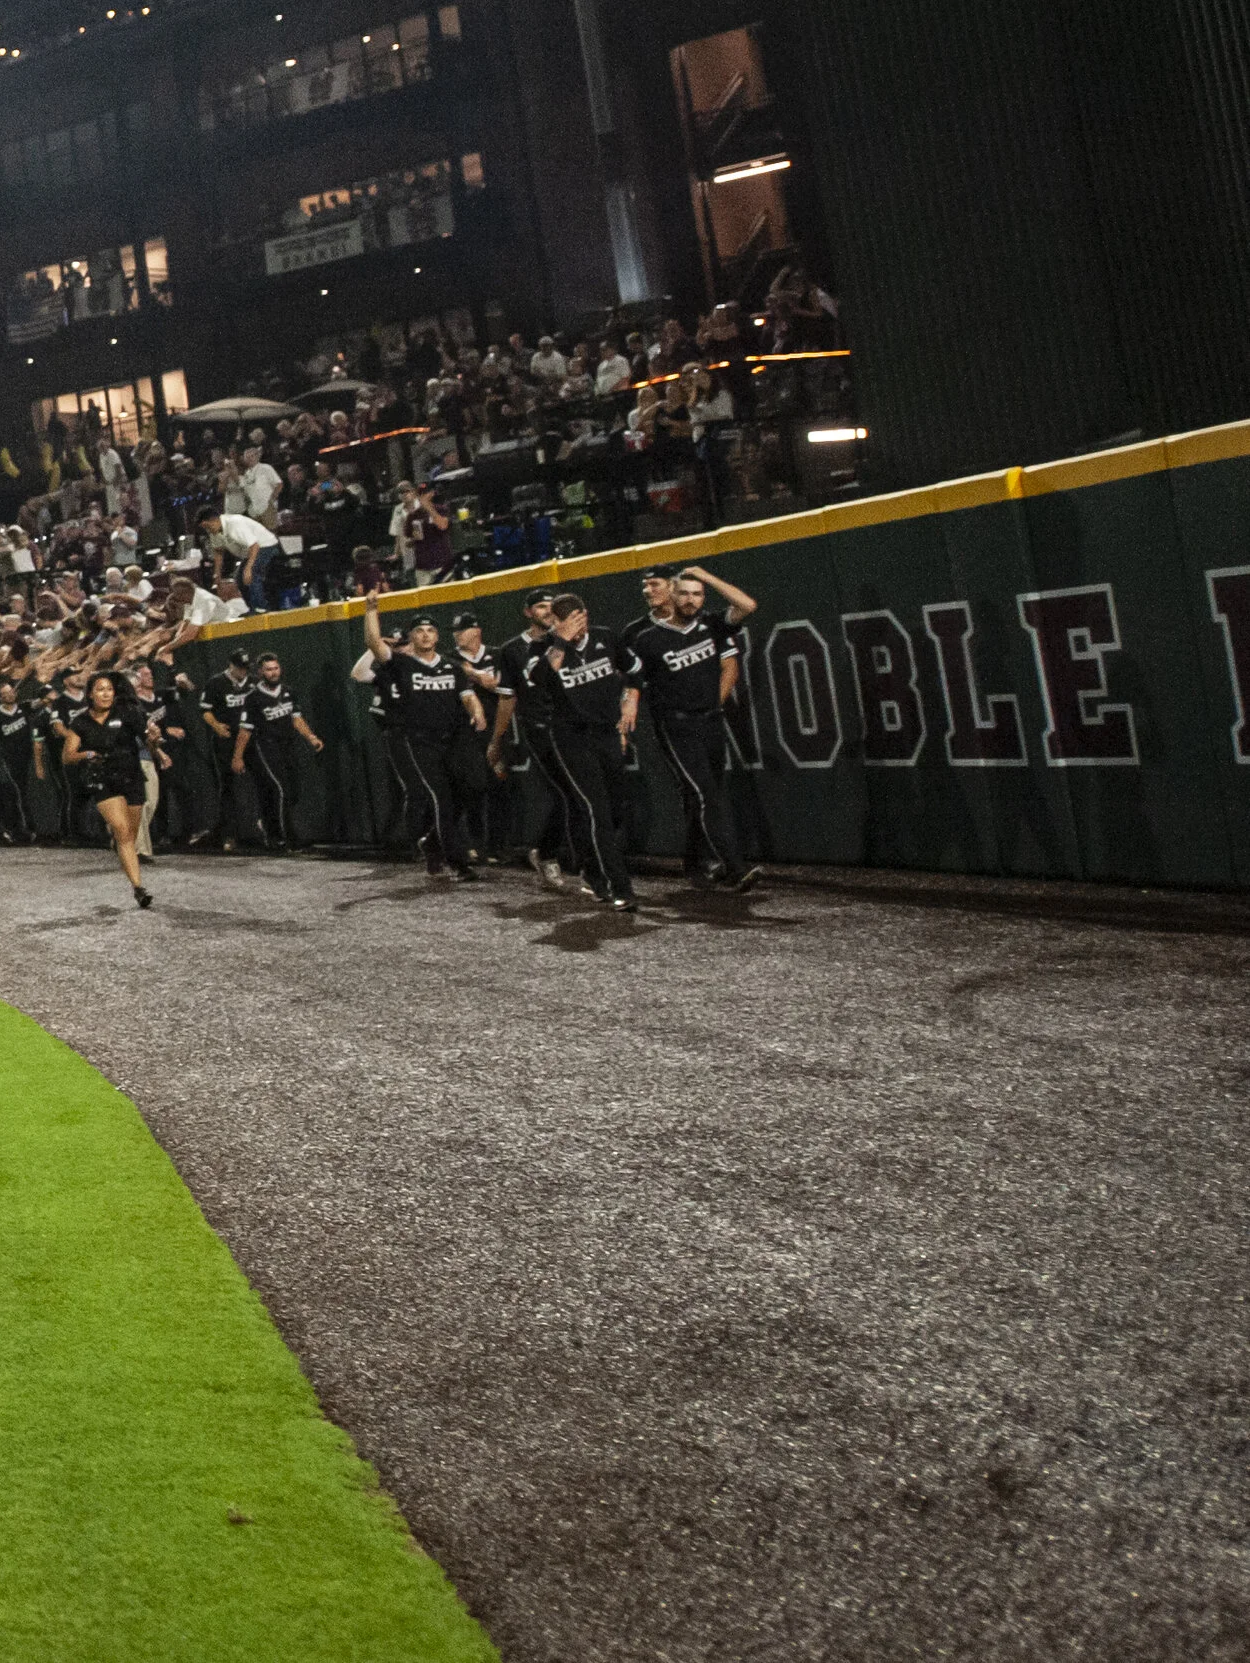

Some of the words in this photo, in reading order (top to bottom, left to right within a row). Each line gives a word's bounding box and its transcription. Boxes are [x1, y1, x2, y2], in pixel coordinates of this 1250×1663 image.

[662, 643, 716, 672] STATE
[411, 672, 456, 691] STATE
[558, 662, 613, 689] STATE
